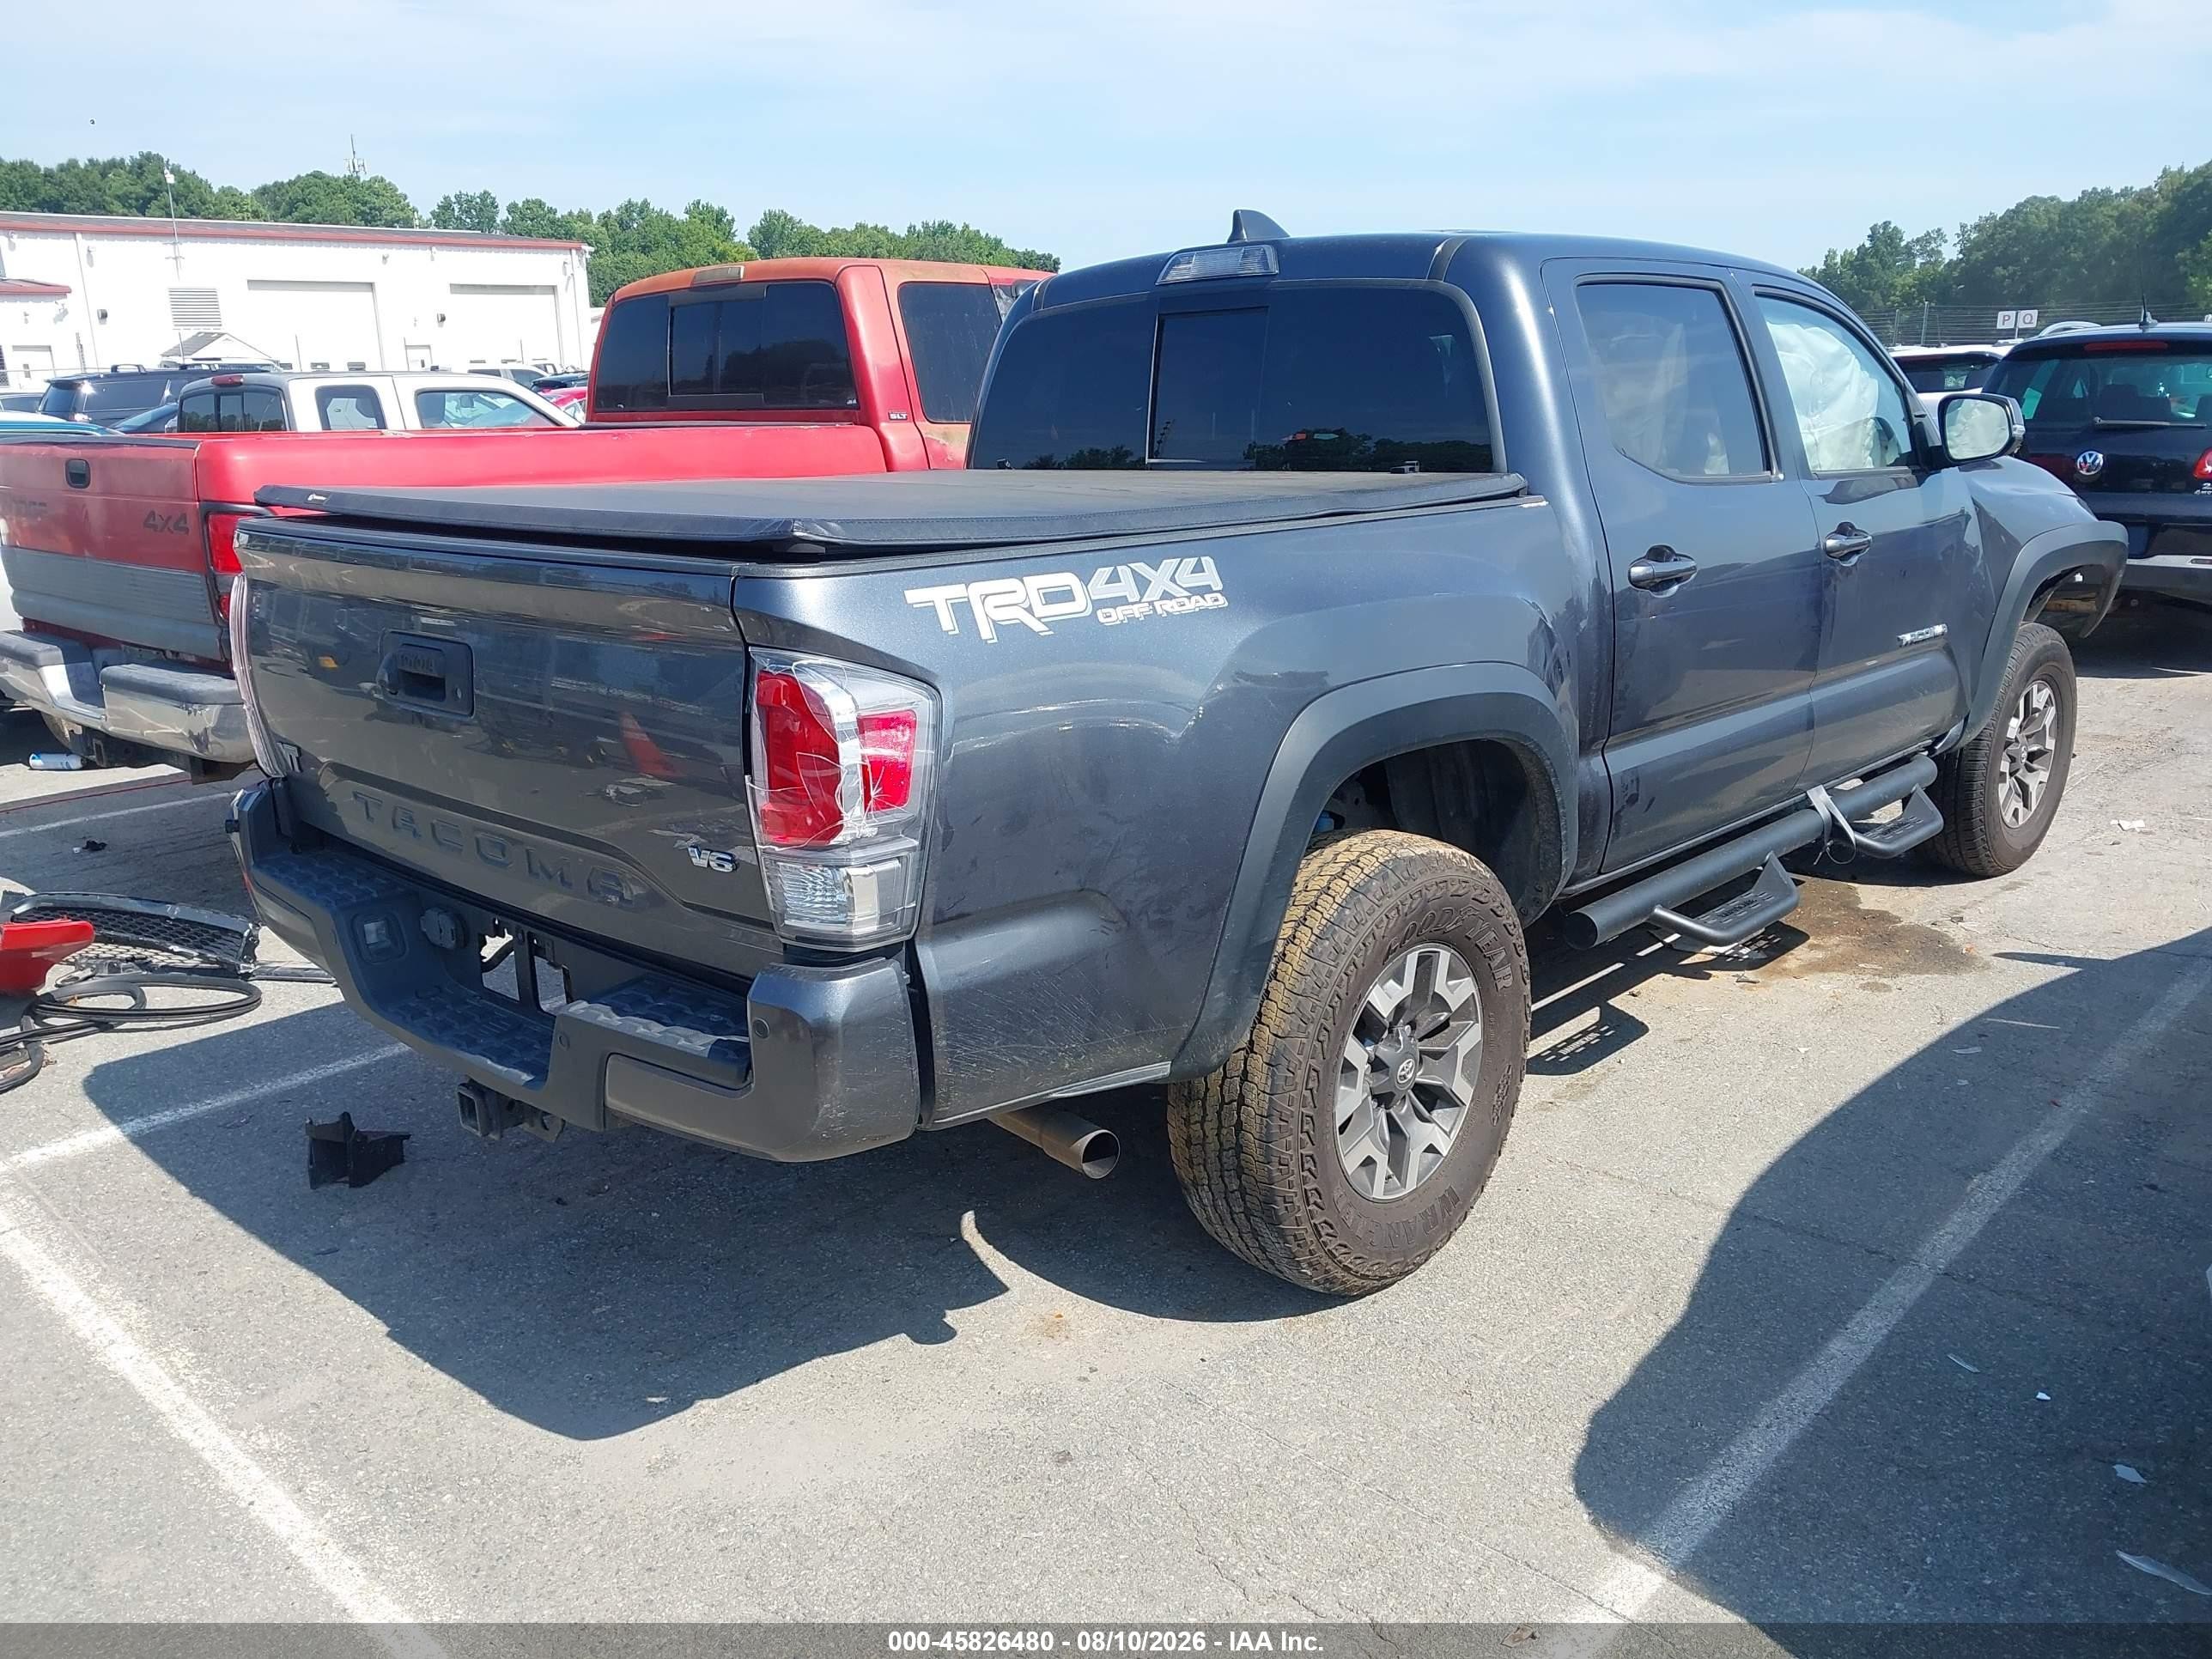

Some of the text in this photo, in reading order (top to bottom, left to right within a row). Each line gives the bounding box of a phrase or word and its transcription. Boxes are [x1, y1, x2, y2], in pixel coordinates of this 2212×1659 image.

[2002, 314, 2010, 325] P
[2022, 313, 2033, 325] Q
[903, 556, 1224, 644] TRD 4X4
[1096, 592, 1229, 626] OFF ROAD
[351, 791, 635, 906] TACOMA
[688, 845, 737, 872] V6
[1382, 905, 1514, 993] GOODYEAR
